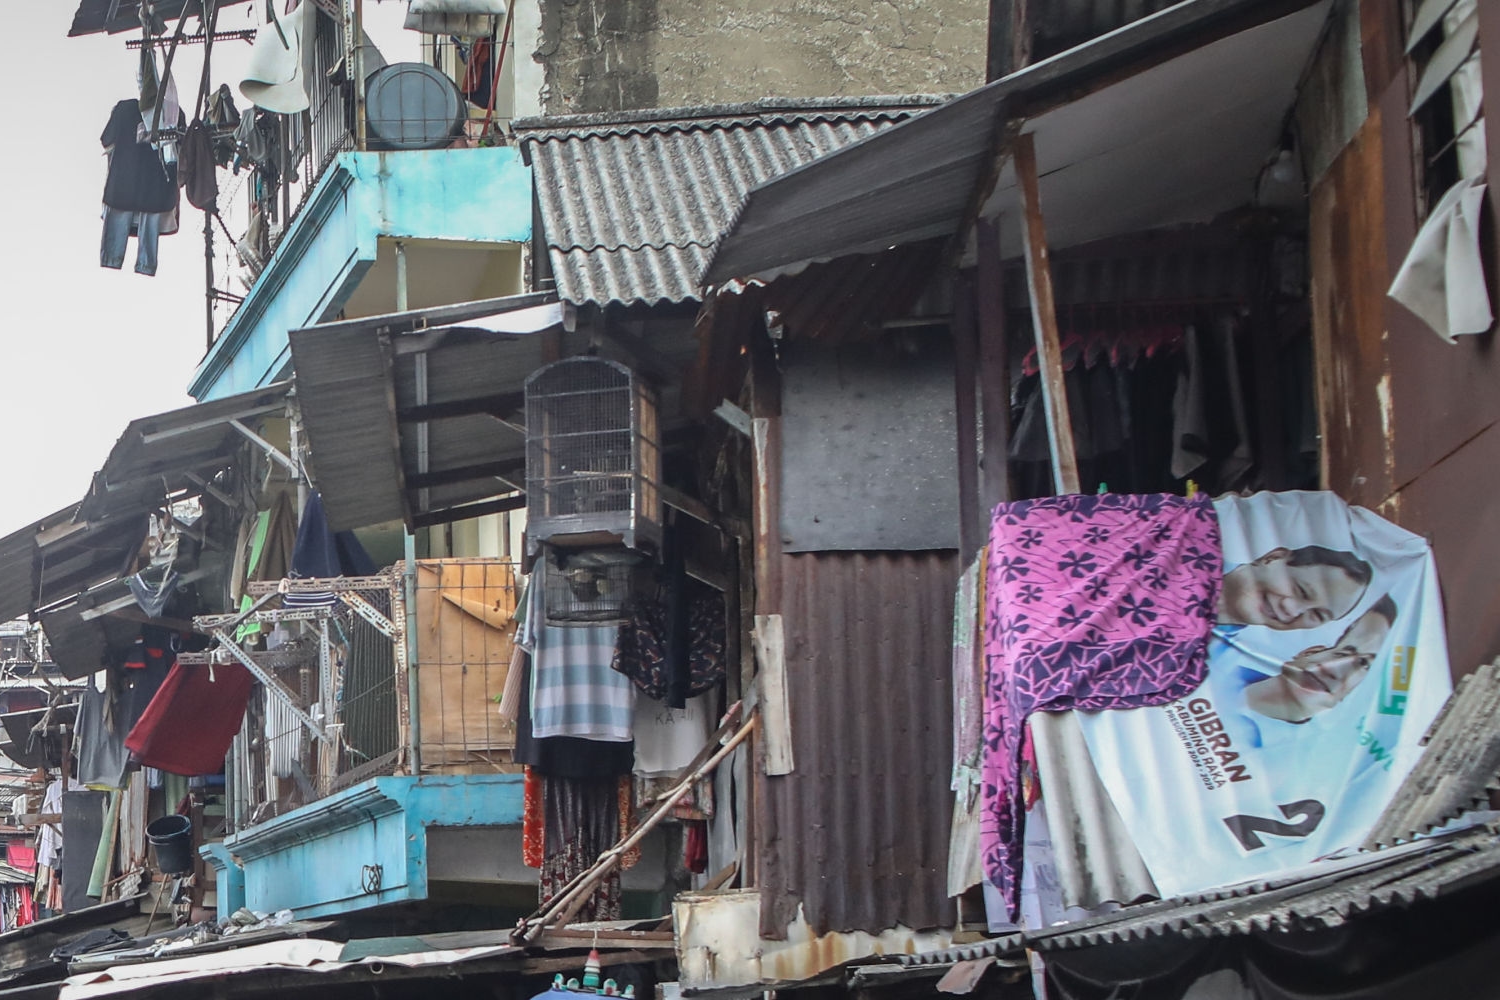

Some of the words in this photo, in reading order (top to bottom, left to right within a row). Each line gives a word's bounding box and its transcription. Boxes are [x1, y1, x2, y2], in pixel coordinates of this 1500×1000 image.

[1188, 698, 1252, 782] GIBRAN
[1200, 773, 1215, 790] 2029
[1202, 757, 1227, 788] RAKA
[1222, 799, 1326, 851] 2
